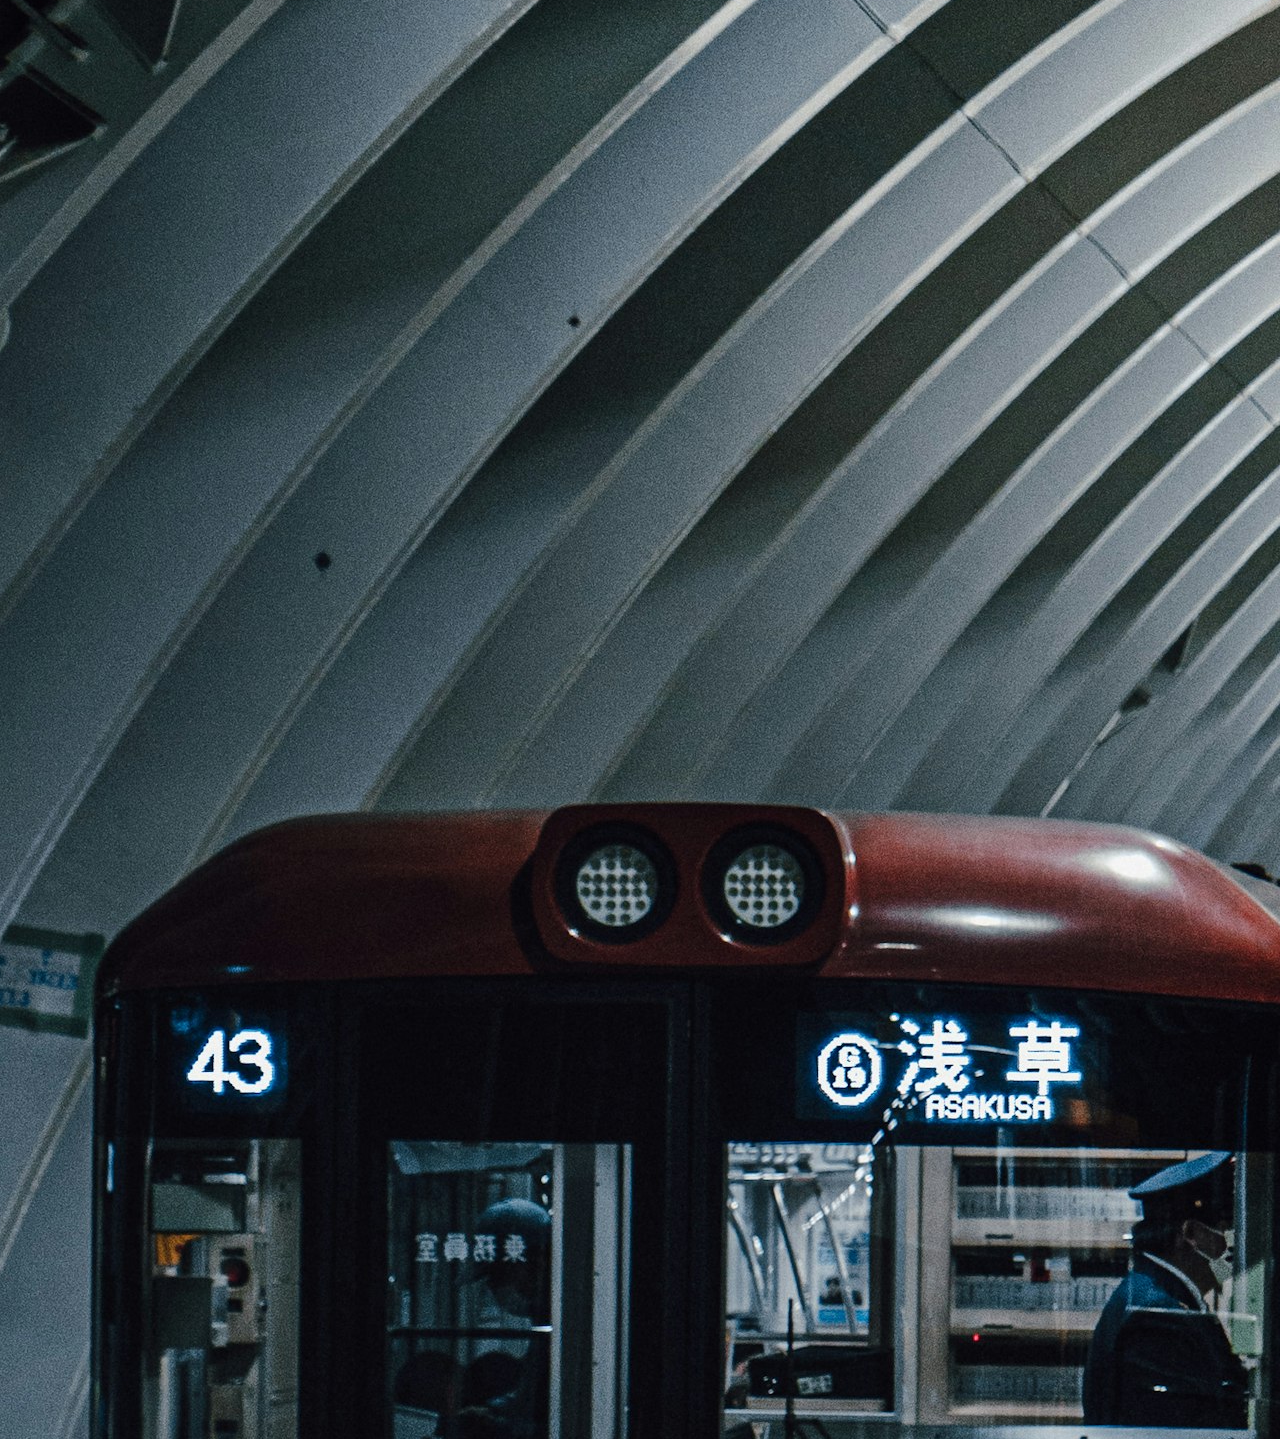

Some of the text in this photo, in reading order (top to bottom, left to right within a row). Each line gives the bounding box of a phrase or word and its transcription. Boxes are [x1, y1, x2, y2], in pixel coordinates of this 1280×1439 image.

[187, 1030, 274, 1093] 43
[832, 1067, 867, 1089] 19
[897, 1019, 1082, 1095] 浅草
[925, 1094, 1052, 1120] ASAKUSA
